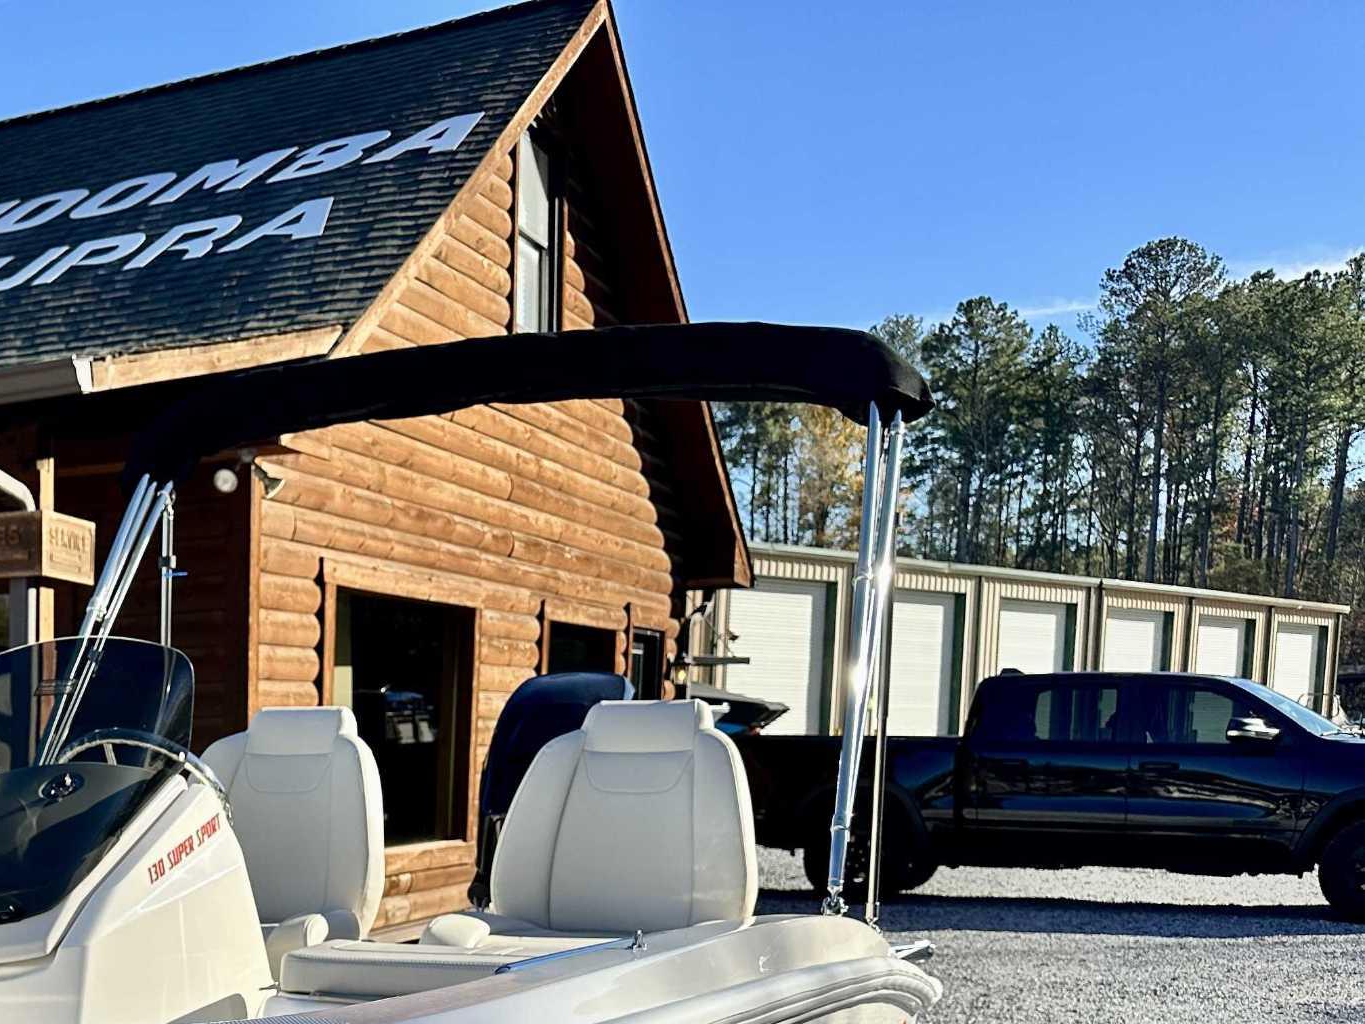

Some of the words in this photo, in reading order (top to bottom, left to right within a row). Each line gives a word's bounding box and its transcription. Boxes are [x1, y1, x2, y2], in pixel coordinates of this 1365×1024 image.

[147, 858, 166, 885] 130
[167, 835, 195, 870] SUPER
[196, 812, 221, 847] SPORT
